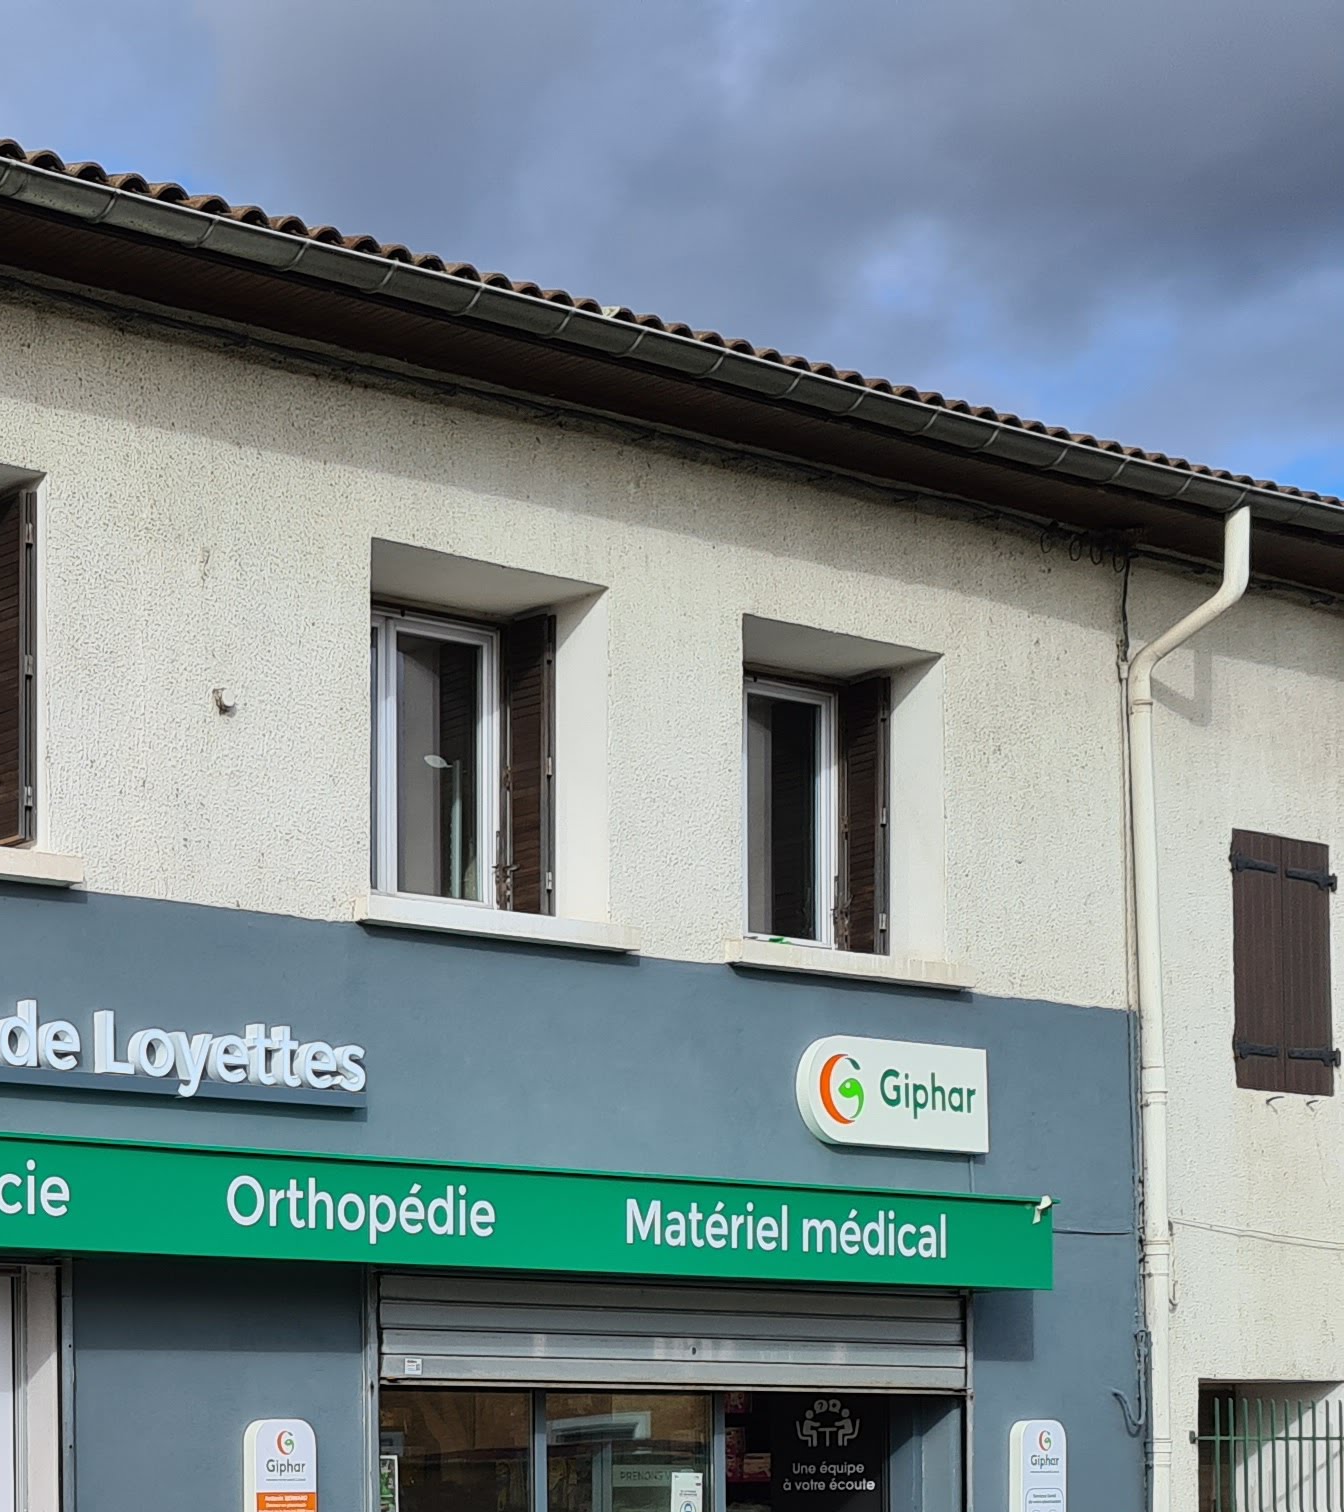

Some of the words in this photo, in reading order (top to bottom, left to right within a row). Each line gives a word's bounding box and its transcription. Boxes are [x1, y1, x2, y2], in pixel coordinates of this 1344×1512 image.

[94, 1010, 366, 1097] Loyettes
[880, 1069, 976, 1119] Giphar
[227, 1175, 495, 1244] Orthopédie
[626, 1198, 788, 1250] Matériel
[802, 1209, 947, 1258] médical
[266, 1459, 306, 1476] Giphar
[792, 1462, 816, 1474] Une
[820, 1461, 865, 1476] équipe
[1031, 1454, 1059, 1470] Giphar
[783, 1478, 792, 1491] à
[794, 1479, 826, 1491] votre
[829, 1478, 876, 1491] écoute
